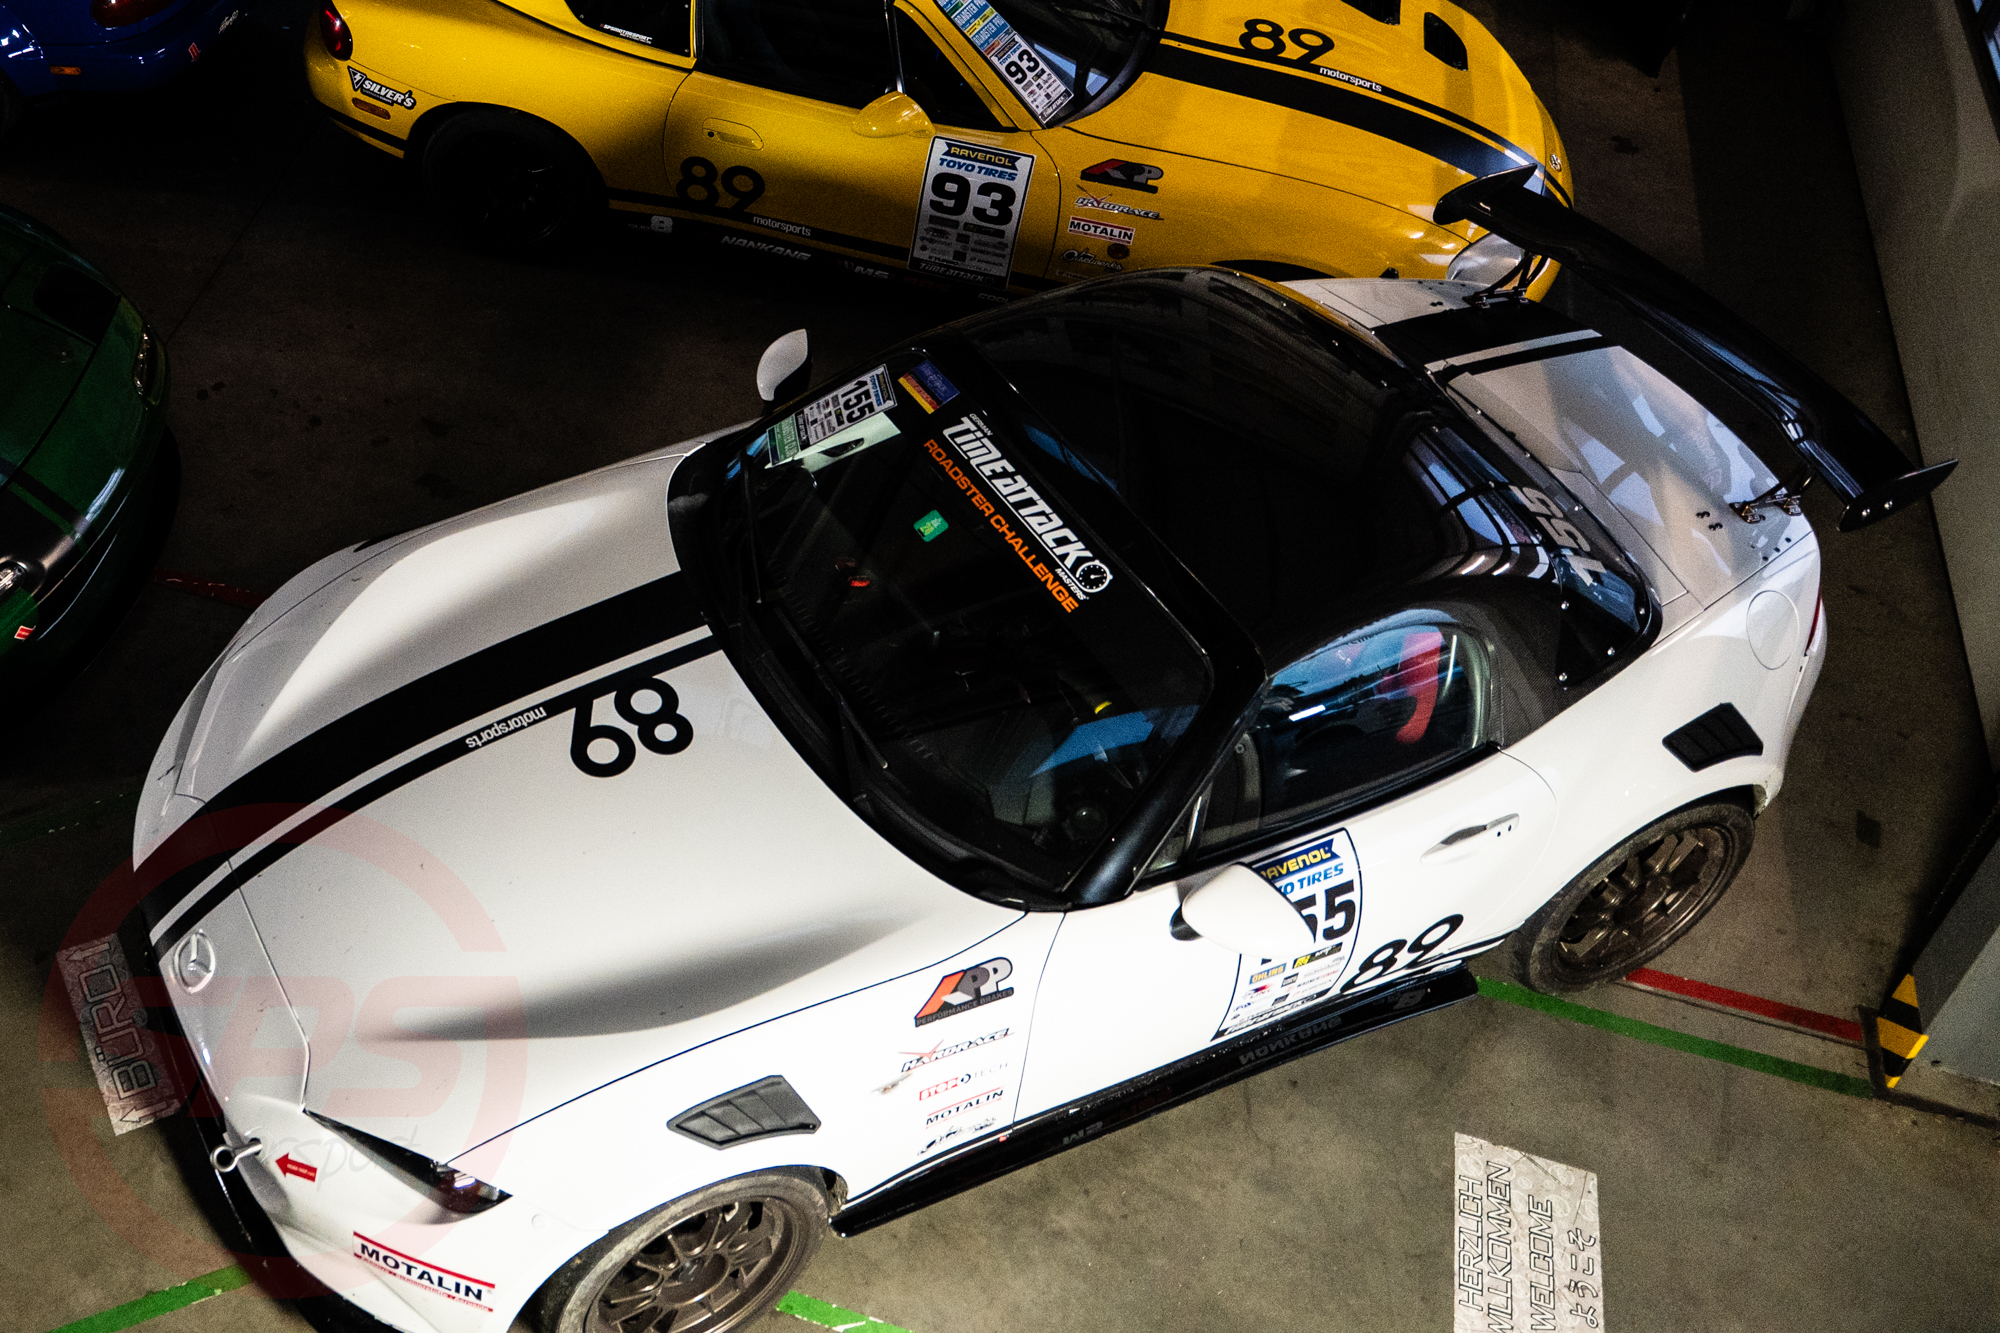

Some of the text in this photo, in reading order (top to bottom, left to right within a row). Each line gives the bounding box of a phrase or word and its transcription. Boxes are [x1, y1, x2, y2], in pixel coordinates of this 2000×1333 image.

[1239, 18, 1335, 64] 89
[1005, 49, 1040, 85] 93
[1319, 66, 1382, 92] motorsports
[363, 80, 414, 107] SILVER'S
[939, 158, 1018, 182] TOYO TIRES
[950, 147, 1012, 166] RAVENOL
[676, 156, 765, 212] 89
[930, 172, 1016, 226] 93
[721, 236, 811, 261] NANKANG
[753, 215, 811, 236] motorsports
[1069, 220, 1134, 241] MOTALIN
[841, 379, 875, 424] 155
[969, 413, 993, 436] GERMAN
[923, 438, 995, 517] ROADSTER
[990, 513, 1079, 613] CHALLENGE
[991, 474, 1094, 569] ATTACK
[1508, 485, 1607, 587] 155
[465, 706, 547, 748] motorsports
[570, 677, 694, 778] 89
[1298, 863, 1344, 894] TIRES
[1285, 879, 1356, 949] 55
[1340, 913, 1464, 995] 89
[917, 988, 1013, 1025] PERFORMANCE BRAKES
[78, 963, 157, 1100] BÜRO
[926, 1089, 1004, 1126] MOTALIN
[1459, 1175, 1483, 1311] HERZLICH
[1487, 1160, 1513, 1333] WILLKOMMEN
[1528, 1194, 1556, 1331] WELCOME
[361, 1242, 482, 1301] MOTALIN
[1567, 1227, 1599, 1328] ようこそ
